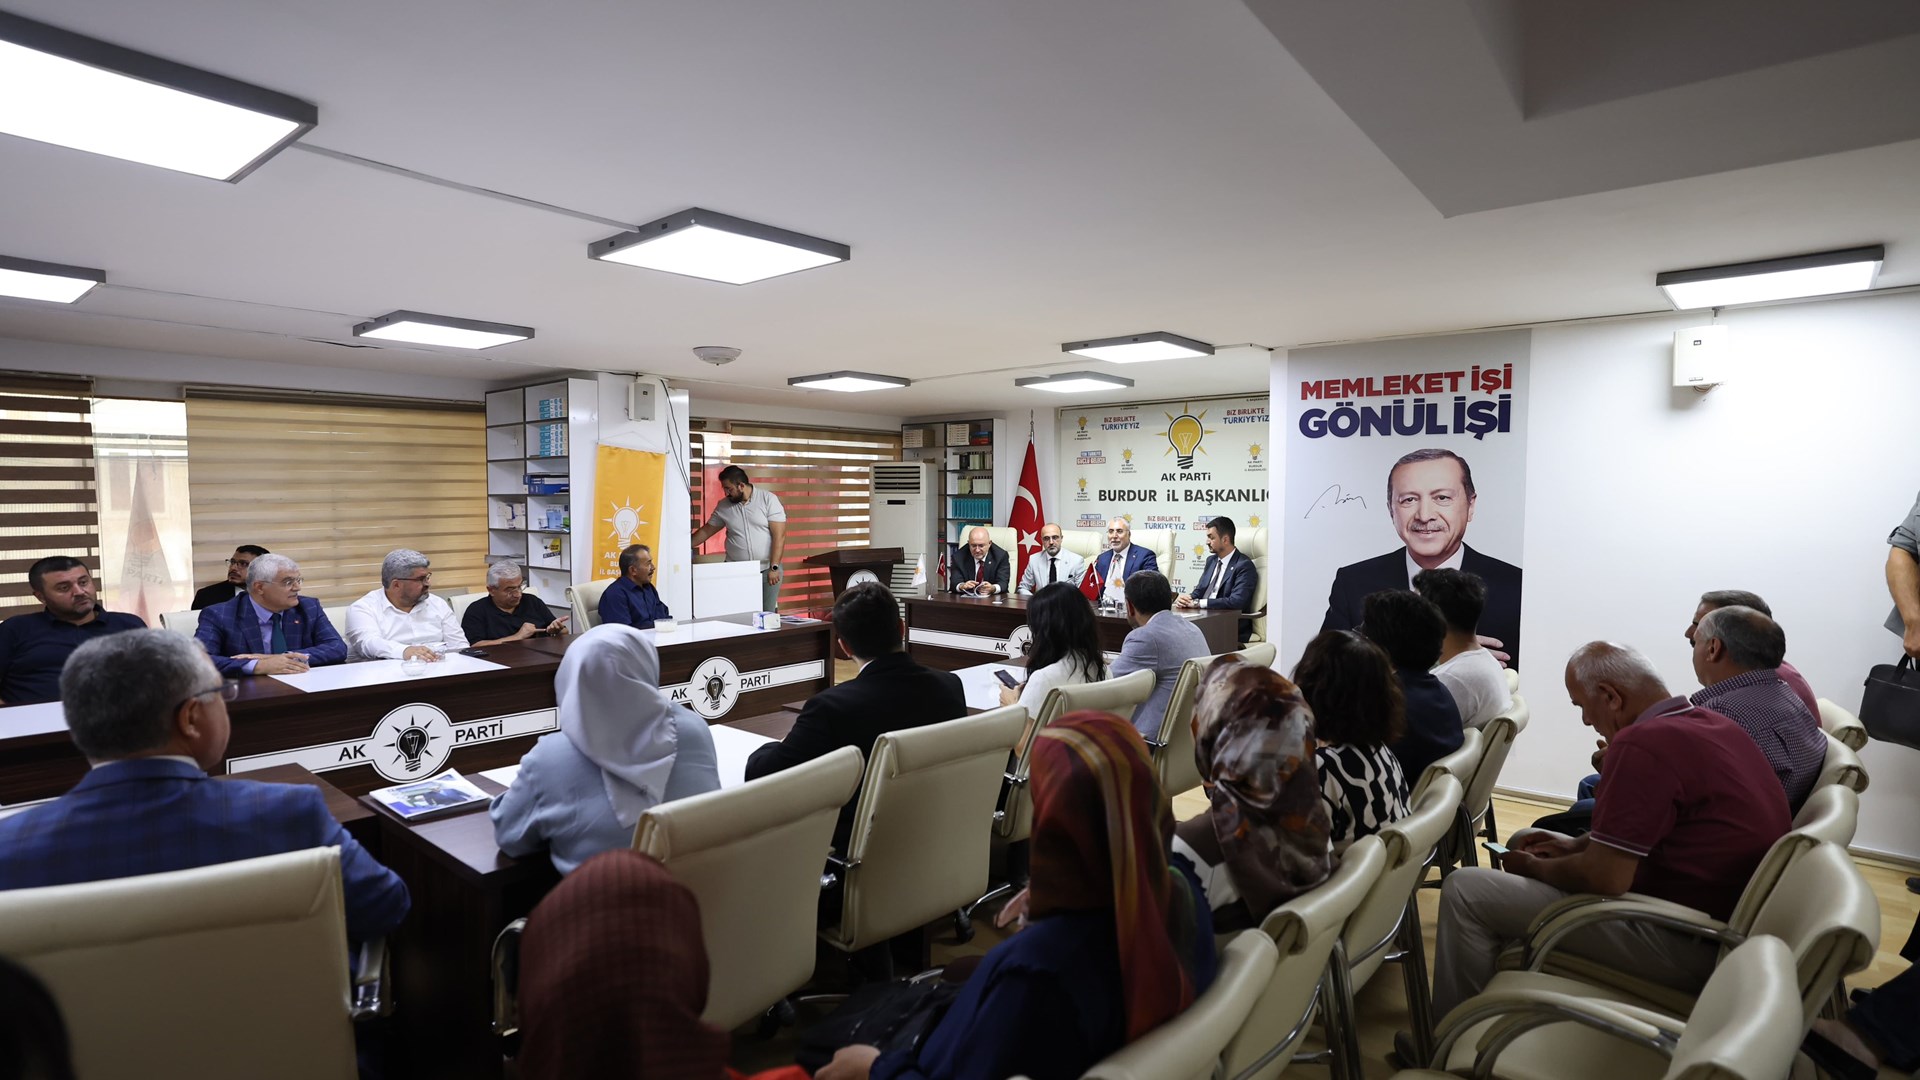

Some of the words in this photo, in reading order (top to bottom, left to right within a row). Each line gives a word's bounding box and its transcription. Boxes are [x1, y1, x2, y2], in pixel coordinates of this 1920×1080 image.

[1301, 370, 1465, 400] MEMLEKET
[1471, 363, 1513, 395] İŞİ
[1299, 398, 1448, 439] GÖNÜL
[1453, 394, 1512, 441] İŞİ
[1161, 472, 1176, 481] AK
[1098, 489, 1157, 502] BURDUR
[1184, 488, 1269, 506] BAŞKANLI
[604, 551, 616, 559] AK
[994, 642, 1007, 651] AK
[671, 687, 688, 700] AK
[740, 672, 771, 689] PARTİ
[338, 744, 367, 762] AK
[455, 720, 504, 743] PARTİ
